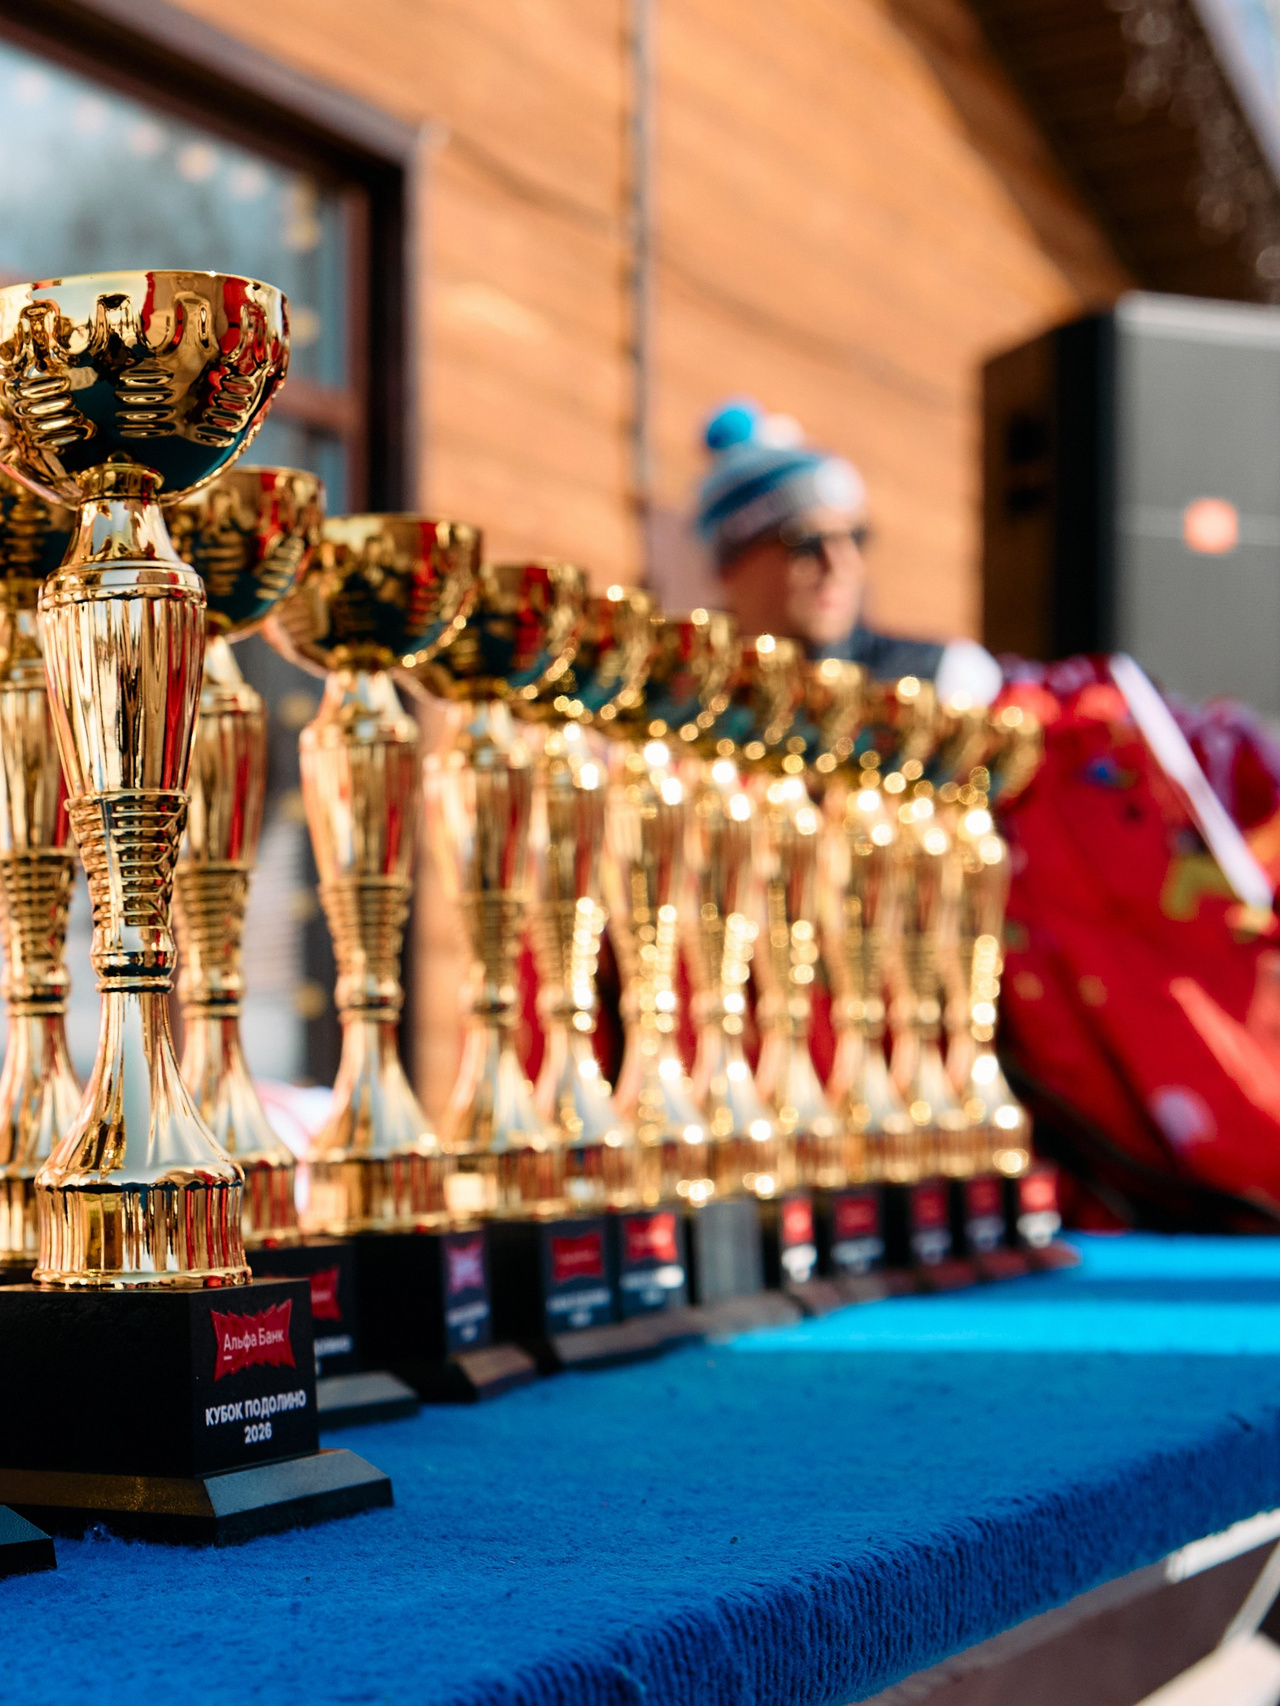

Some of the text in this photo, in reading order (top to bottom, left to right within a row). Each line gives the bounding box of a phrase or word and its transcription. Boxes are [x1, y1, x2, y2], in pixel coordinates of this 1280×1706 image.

[224, 1329, 257, 1360] Альфа
[258, 1327, 284, 1346] Банк
[205, 1389, 307, 1427] КУБОК ПОДОЛИНО
[244, 1421, 273, 1444] 2026
